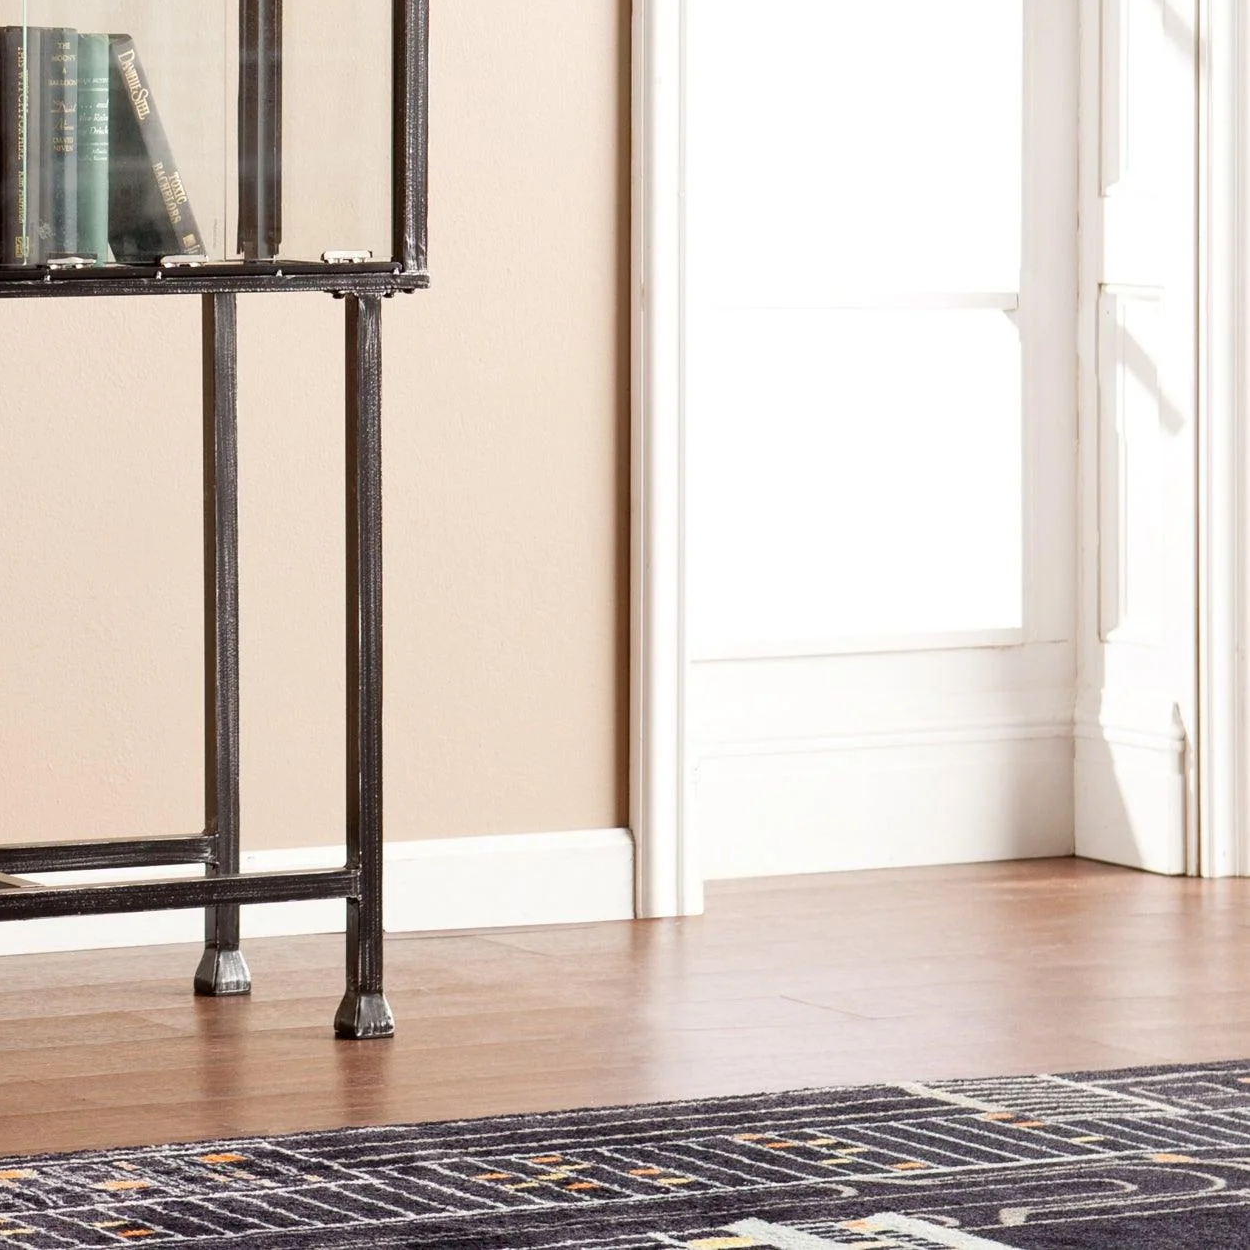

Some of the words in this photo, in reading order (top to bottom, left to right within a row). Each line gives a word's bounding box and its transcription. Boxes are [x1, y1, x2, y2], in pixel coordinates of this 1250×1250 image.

[117, 49, 142, 92] DANIELLE
[131, 88, 151, 120] STEEL
[152, 161, 182, 224] BACHELORS
[169, 171, 188, 204] TOXIC
